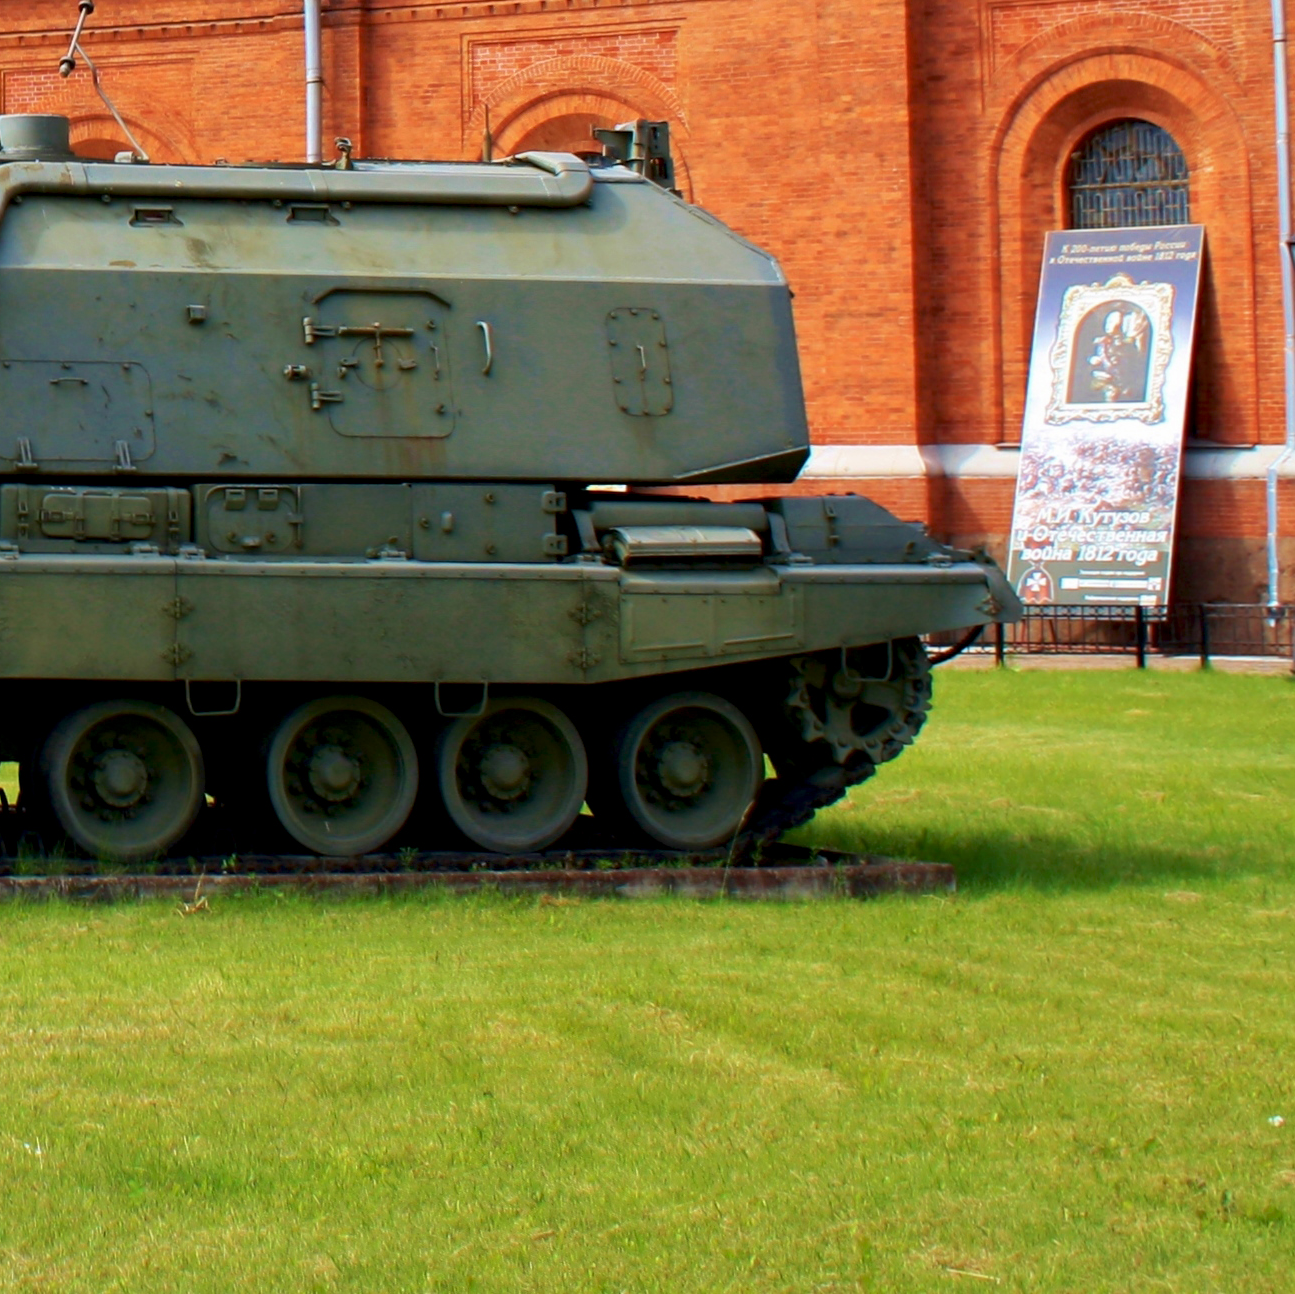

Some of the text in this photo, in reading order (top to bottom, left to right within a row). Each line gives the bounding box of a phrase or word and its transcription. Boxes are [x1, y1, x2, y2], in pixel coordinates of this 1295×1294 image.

[1061, 240, 1187, 253] К 200-летию победы России
[1057, 254, 1124, 264] Отечественной
[1125, 253, 1153, 262] войне
[1154, 251, 1175, 261] 1812
[1175, 251, 1197, 261] года
[1035, 507, 1150, 527] М.И. Кутузов
[1016, 526, 1169, 543] и Отечественная
[1019, 545, 1159, 566] война 1812 года
